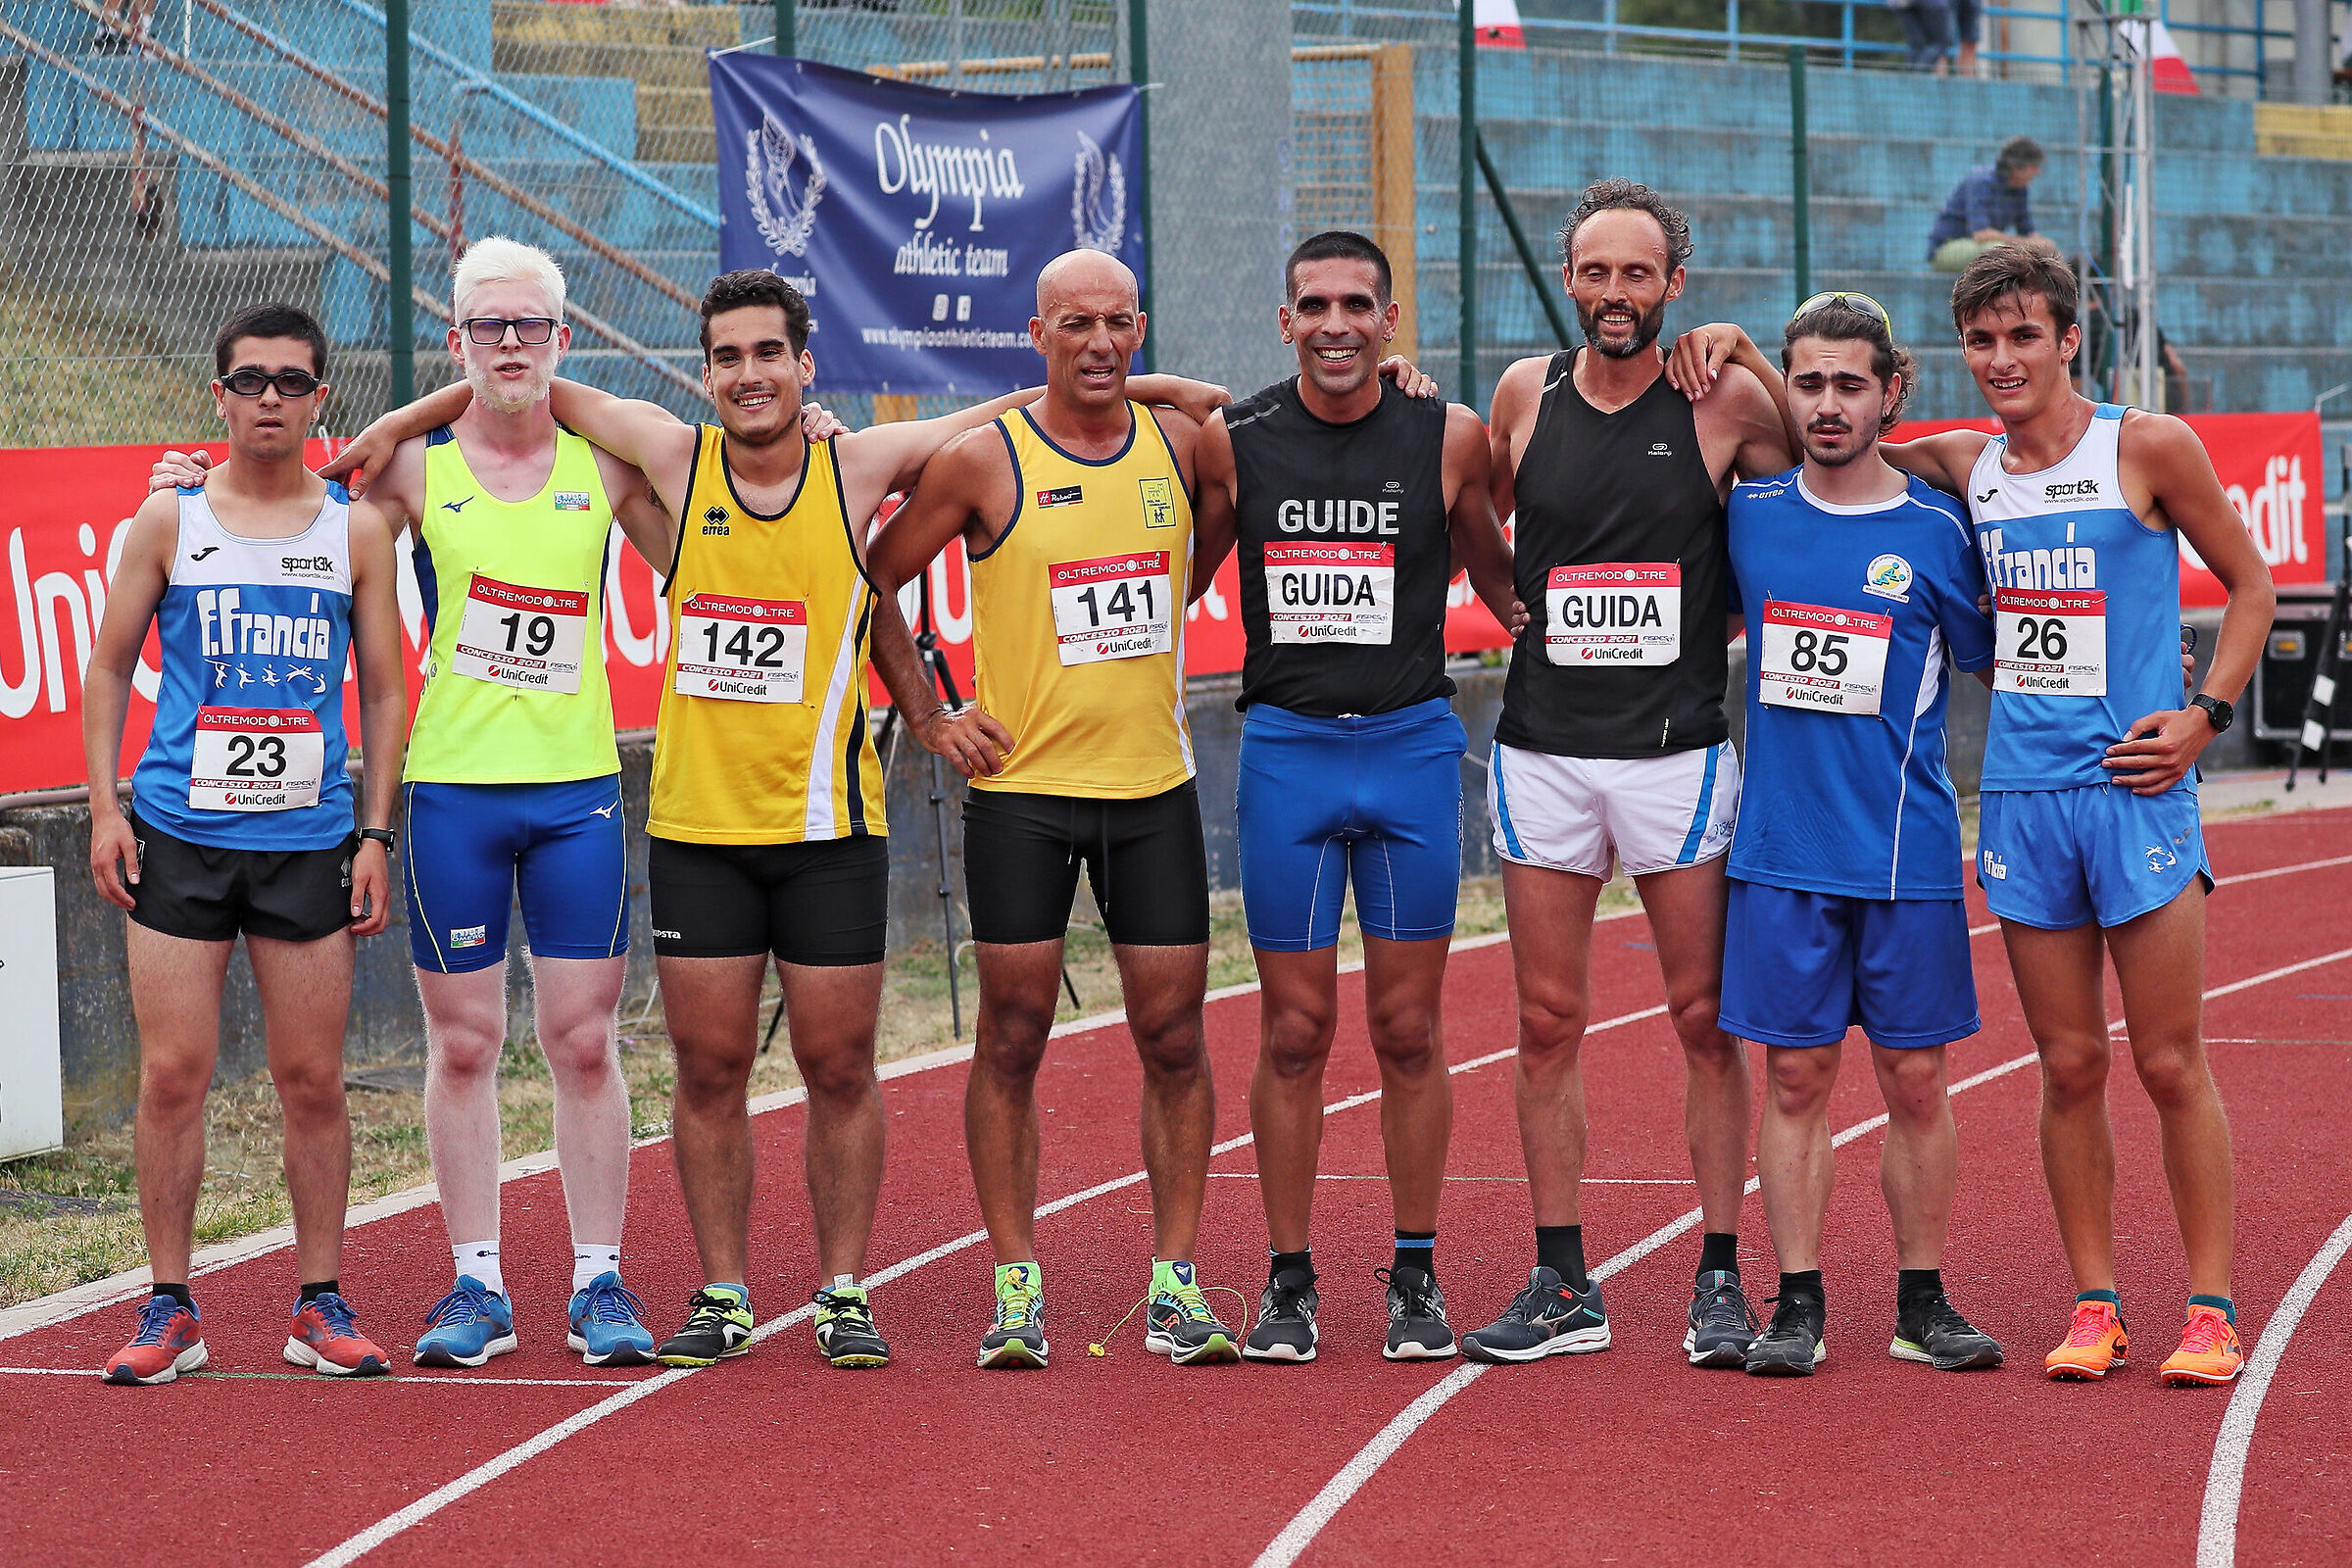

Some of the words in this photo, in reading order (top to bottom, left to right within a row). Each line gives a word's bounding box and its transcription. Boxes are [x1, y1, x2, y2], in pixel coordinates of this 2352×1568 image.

[875, 114, 1024, 230] Olympia
[894, 230, 961, 275] athletic
[965, 243, 1009, 277] team
[2045, 479, 2099, 499] sport3k
[1278, 499, 1399, 535] GUIDE
[702, 525, 730, 536] errea
[281, 557, 334, 572] sport3k
[1555, 569, 1667, 582] OLTREMODOLTRE
[476, 584, 578, 609] OLTREMODOLTRE
[1282, 572, 1376, 607] GUIDA
[689, 601, 795, 617] OLTREMODOLTRE
[1077, 579, 1153, 627] 141
[2000, 593, 2090, 609] OLTREMODOLTRE
[1562, 595, 1662, 628] GUIDA
[1771, 608, 1879, 630] OLTREMODOLTRE
[501, 612, 556, 657] 19
[1062, 629, 1120, 643] CONCESIO
[1121, 624, 1147, 635] 2021
[1309, 624, 1357, 637] UniCredit
[2017, 616, 2068, 661] 26
[704, 621, 785, 667] 142
[1110, 638, 1152, 653] UniCredit
[1608, 635, 1637, 644] 2021
[460, 646, 516, 665] CONCESIO
[516, 659, 545, 669] 2021
[1594, 648, 1643, 660] UniCredit
[1790, 630, 1849, 676] 85
[501, 667, 549, 685] UniCredit
[682, 664, 732, 676] CONCESIO
[733, 669, 762, 679] 2021
[2036, 663, 2062, 673] 2021
[719, 681, 767, 696] UniCredit
[1763, 672, 1809, 685] CONCESIO
[1810, 678, 1838, 689] 2021
[2026, 675, 2070, 689] UniCredit
[1795, 689, 1843, 706] UniCredit
[203, 714, 310, 727] OLTREMODOLTRE
[226, 735, 286, 777] 23
[194, 780, 251, 789] CONCESIO
[251, 781, 280, 790] 2021
[238, 794, 286, 805] UniCredit
